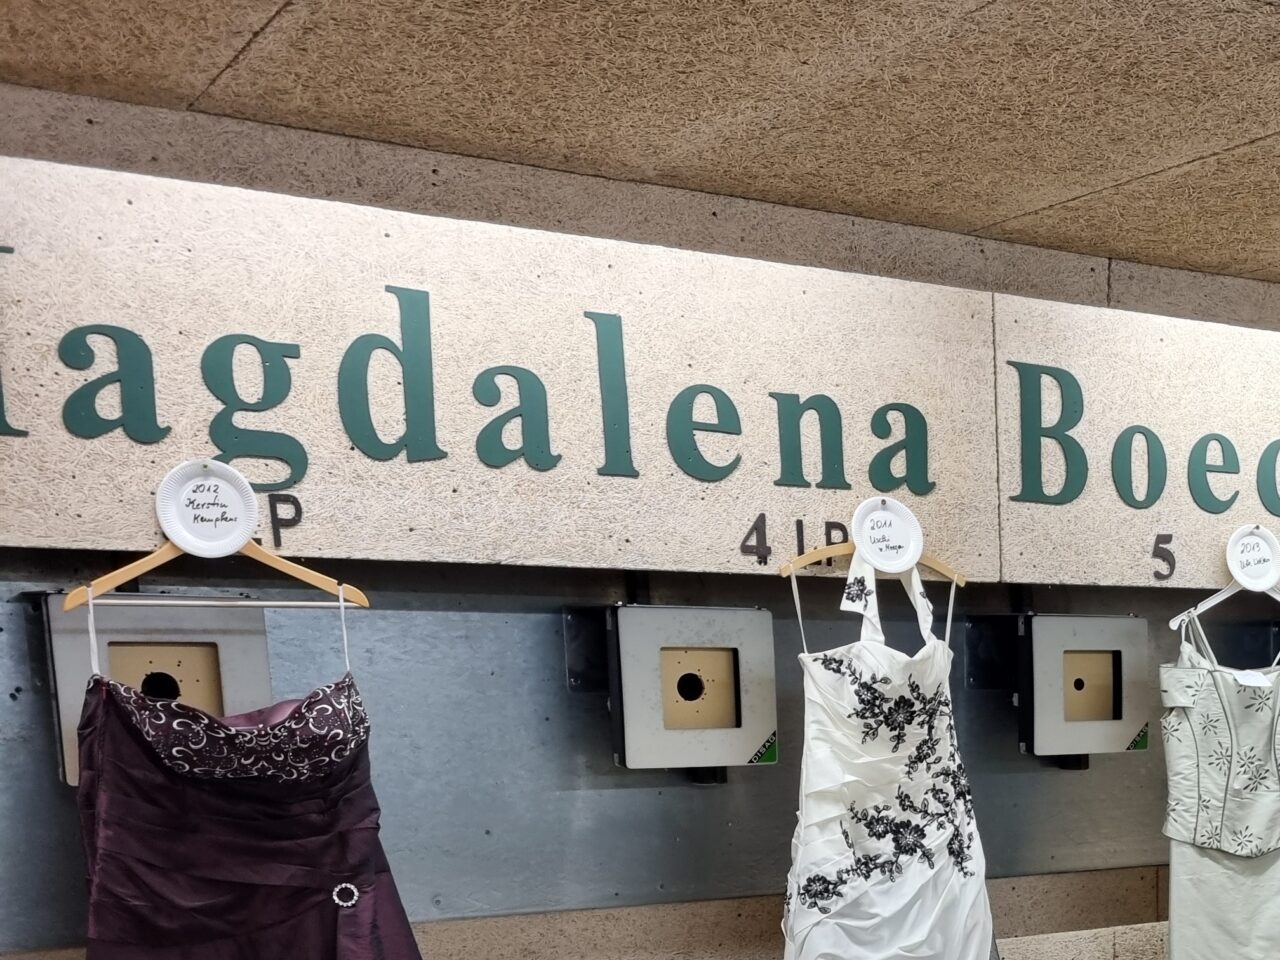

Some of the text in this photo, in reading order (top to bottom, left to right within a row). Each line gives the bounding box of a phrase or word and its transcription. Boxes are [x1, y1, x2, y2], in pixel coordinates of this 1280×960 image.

[0, 246, 936, 496] agdalena
[192, 484, 220, 493] 2012
[740, 513, 772, 566] 4
[870, 518, 893, 530] 2011
[1152, 533, 1176, 581] 5
[751, 734, 777, 763] DISAG
